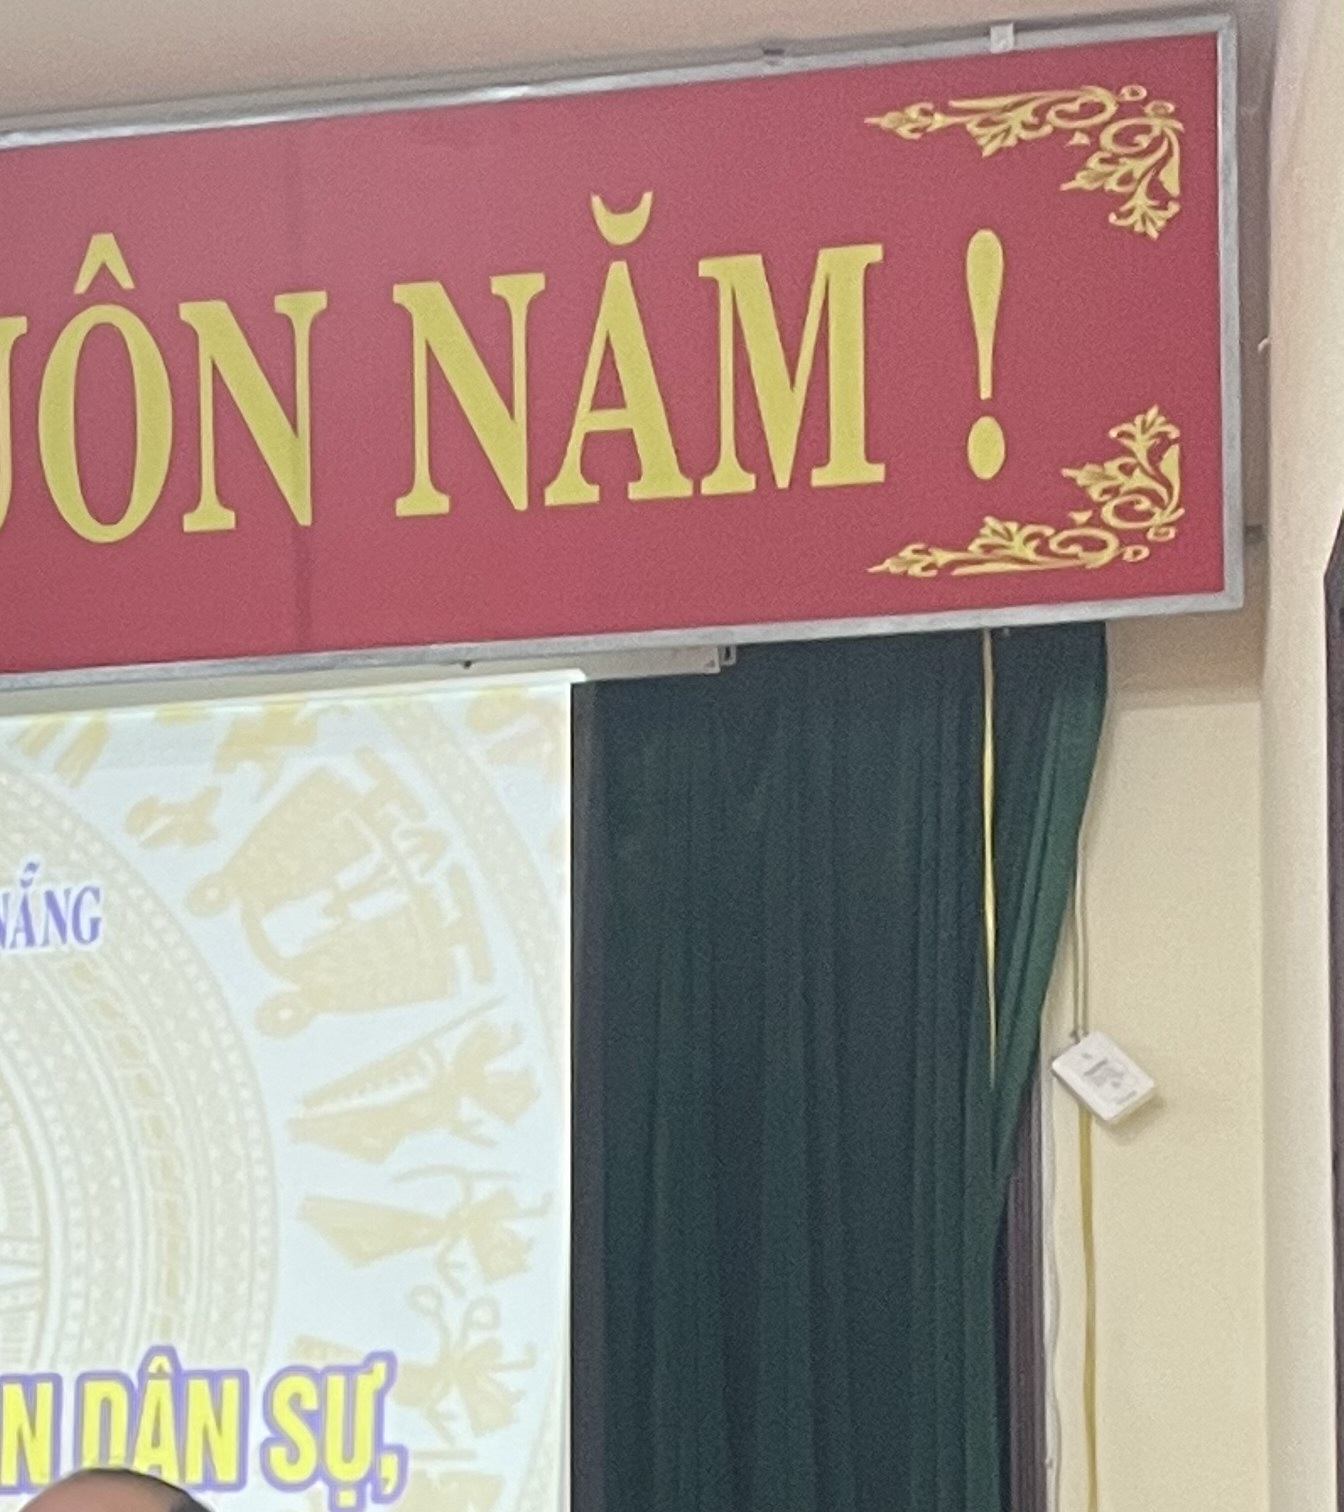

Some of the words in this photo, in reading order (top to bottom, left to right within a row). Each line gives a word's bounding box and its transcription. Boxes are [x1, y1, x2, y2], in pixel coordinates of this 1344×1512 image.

[393, 191, 885, 510] NĂM
[964, 229, 1004, 480] !
[73, 1345, 250, 1493] DÂN
